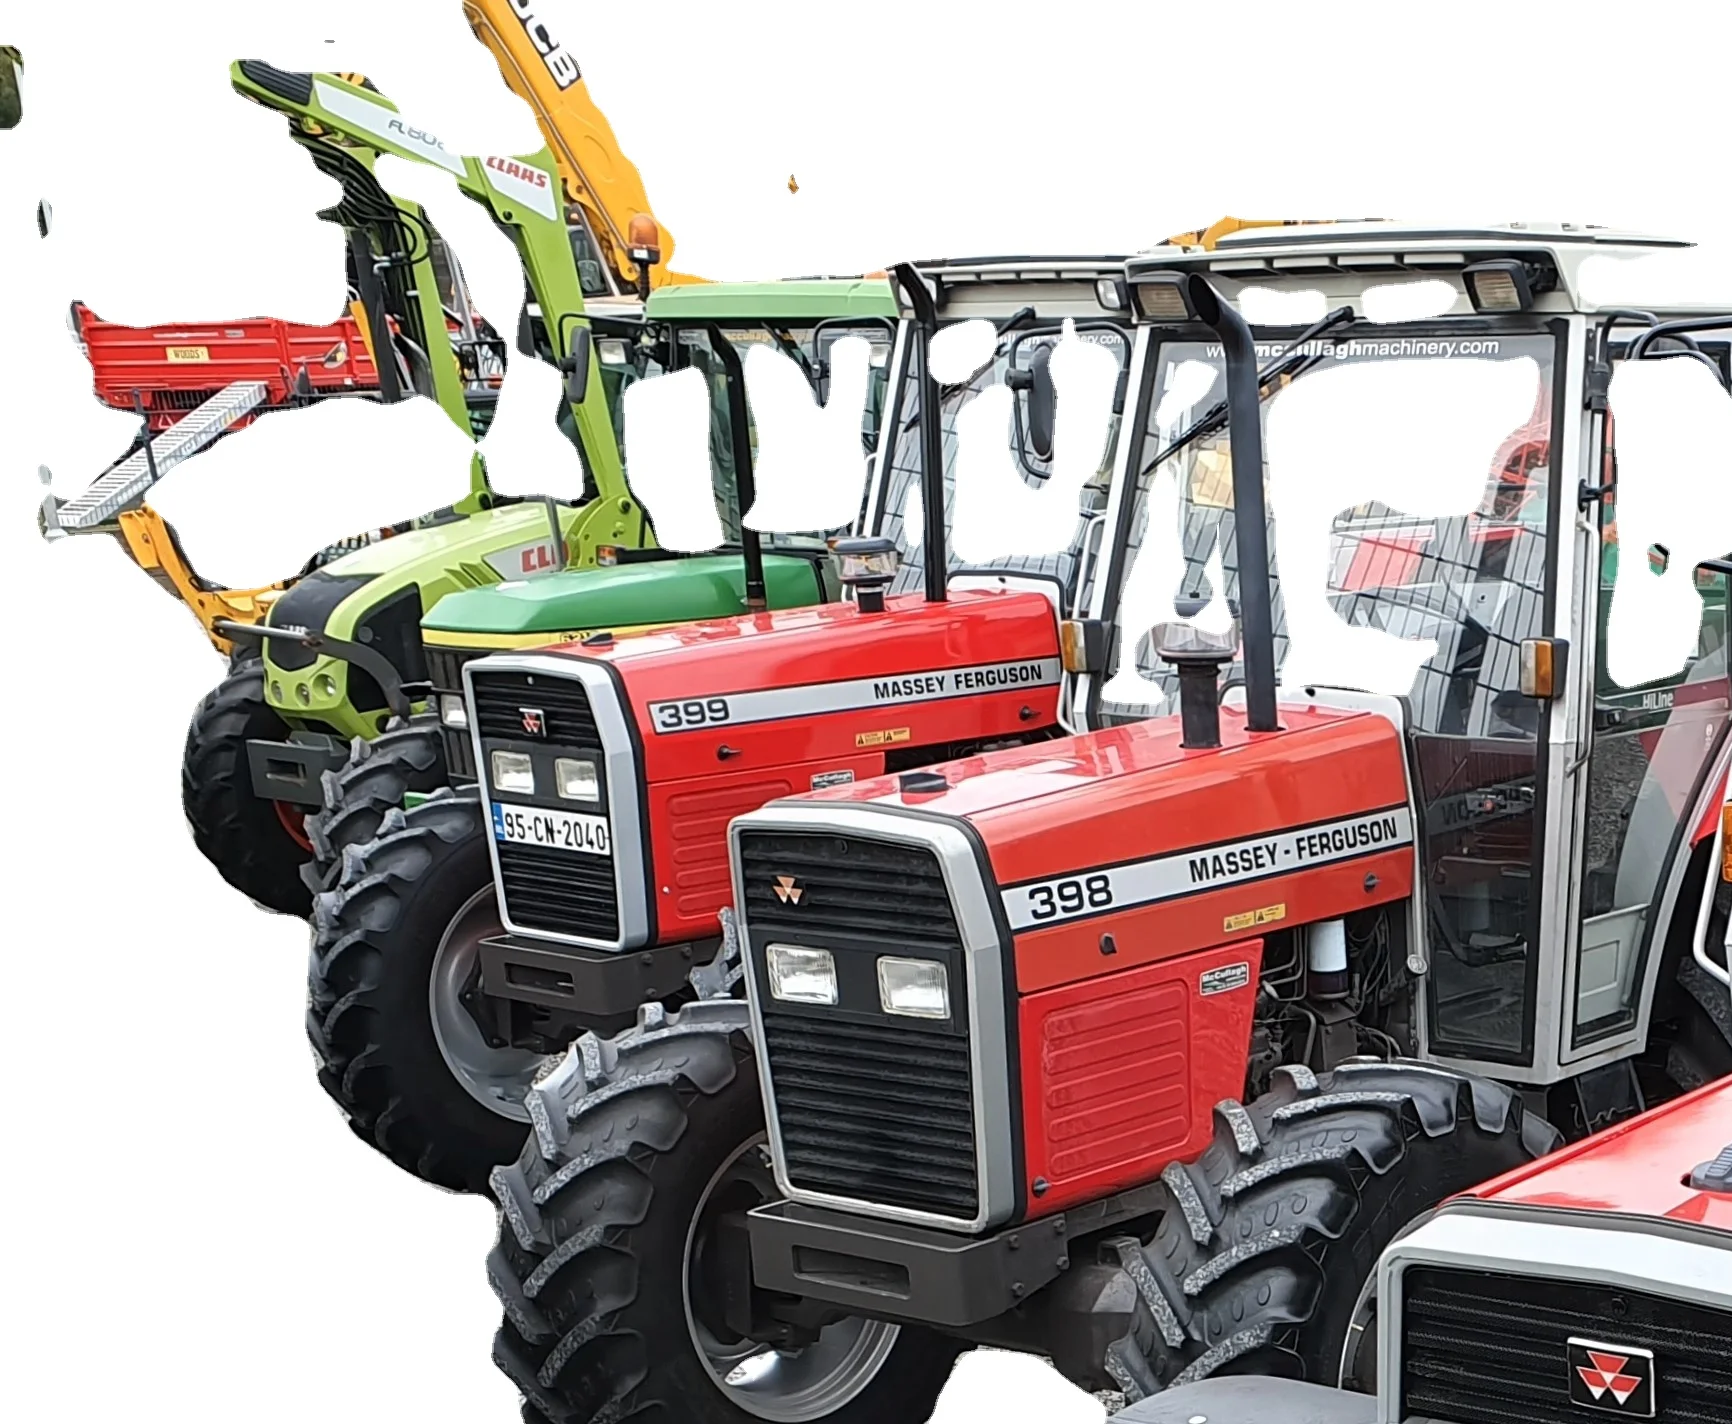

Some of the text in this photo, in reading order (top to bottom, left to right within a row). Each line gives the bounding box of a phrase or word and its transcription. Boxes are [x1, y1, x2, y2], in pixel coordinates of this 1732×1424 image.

[486, 156, 547, 188] CLAAS
[874, 664, 1042, 700] MASSEY FERGUSON
[658, 699, 730, 729] 399
[505, 812, 606, 851] 95-CN-2040
[1189, 843, 1279, 884] MASSEY
[1295, 817, 1398, 861] FERGUSON
[1028, 875, 1113, 920] 398
